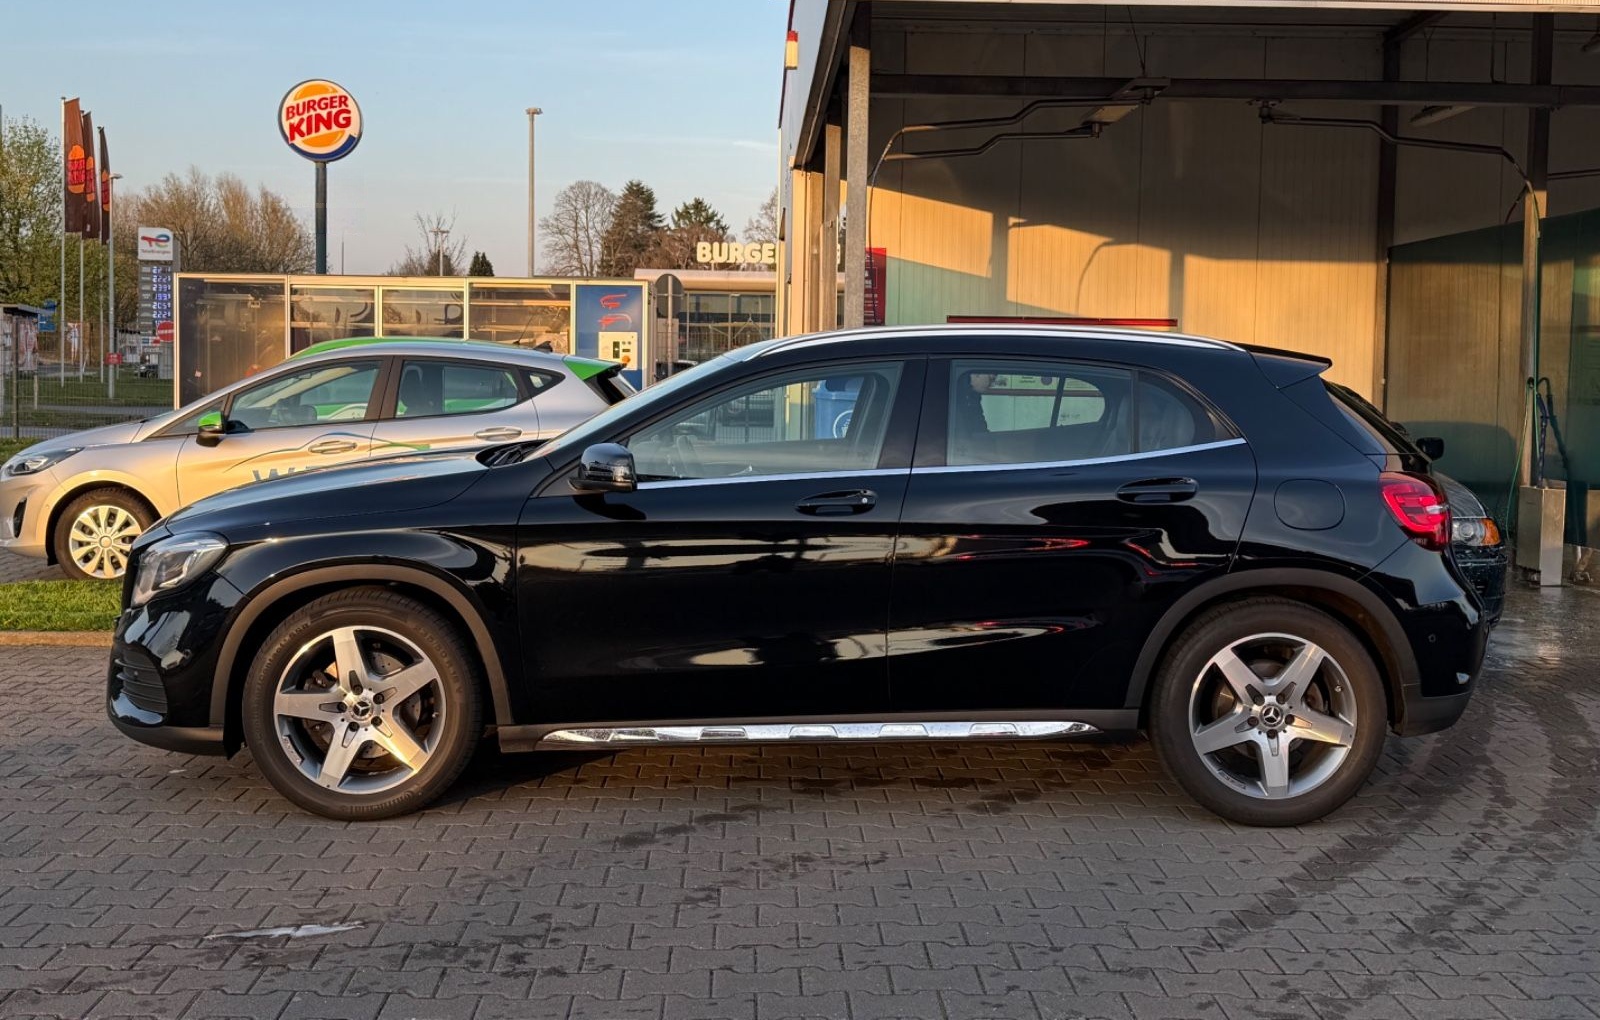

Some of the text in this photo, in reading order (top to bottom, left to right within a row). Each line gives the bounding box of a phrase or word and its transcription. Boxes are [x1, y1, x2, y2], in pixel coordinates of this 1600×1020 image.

[286, 95, 349, 122] BURGER
[289, 108, 352, 142] KING
[696, 241, 779, 264] BURGE
